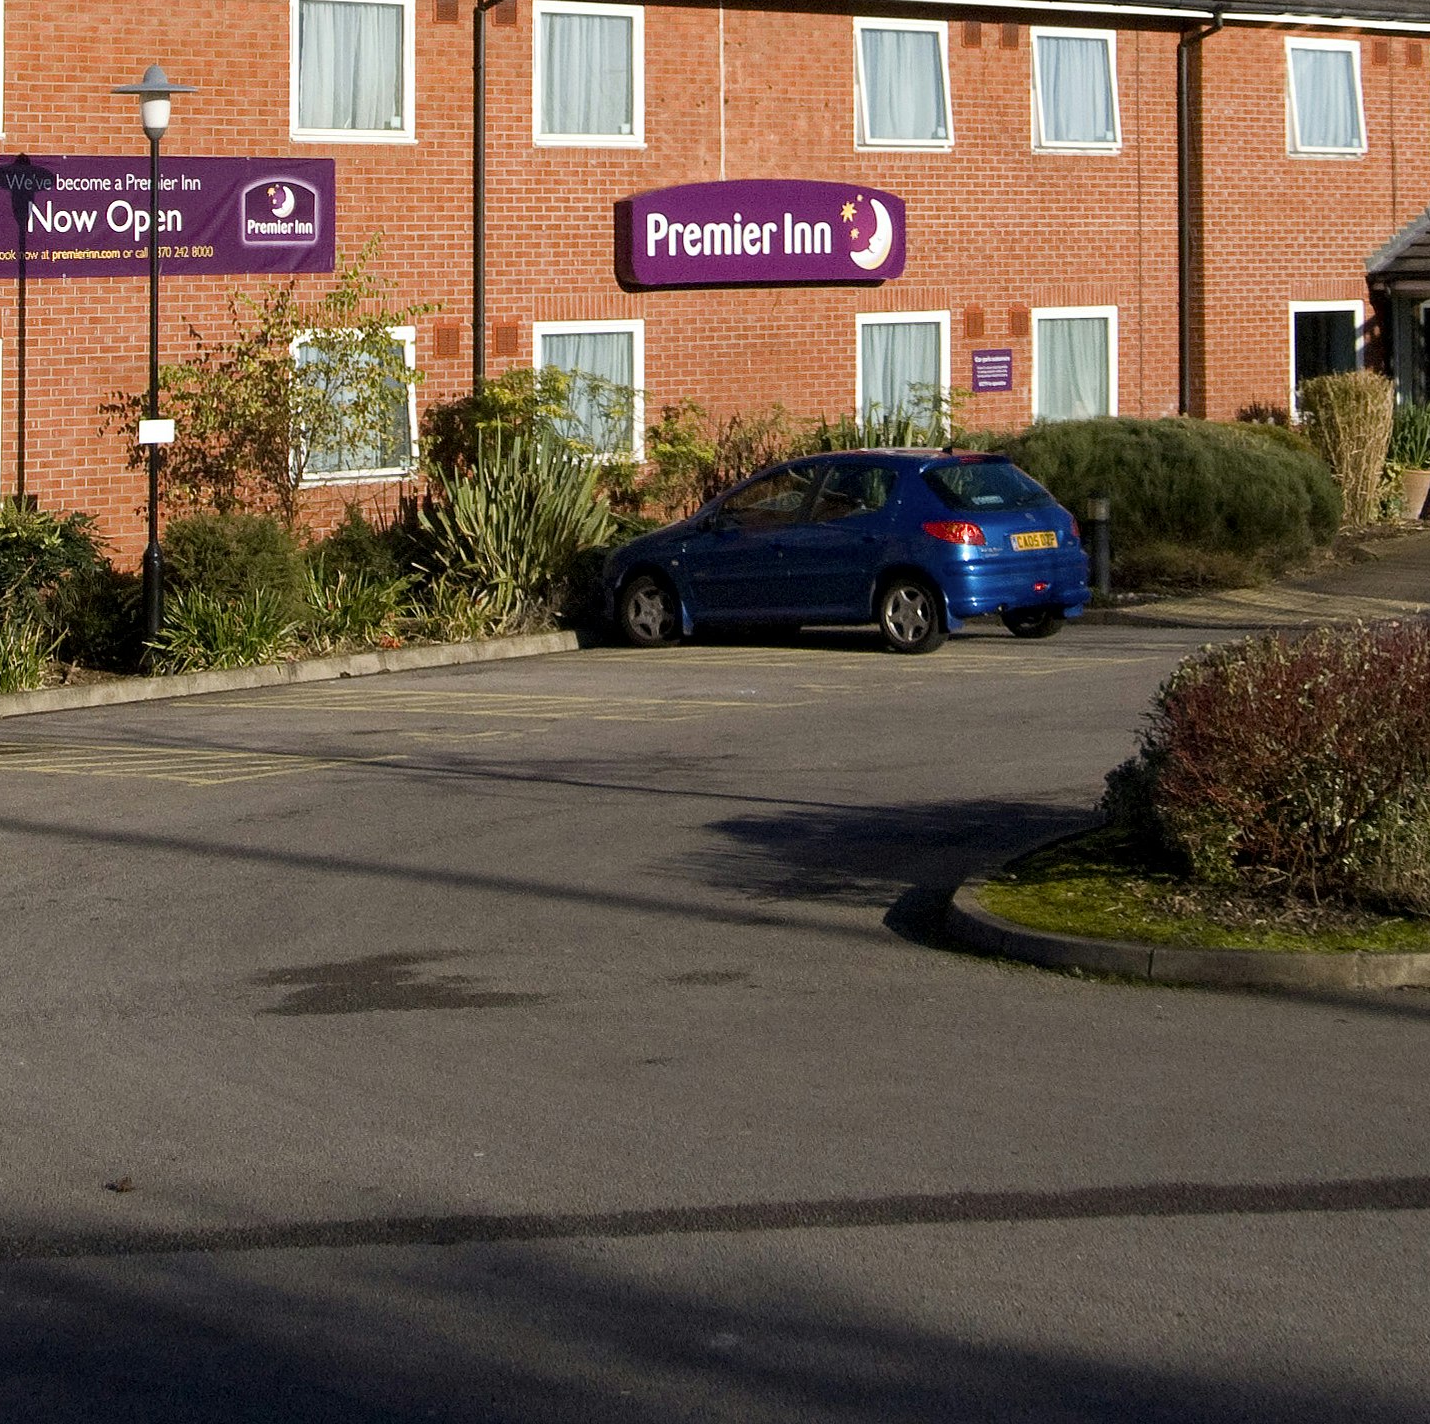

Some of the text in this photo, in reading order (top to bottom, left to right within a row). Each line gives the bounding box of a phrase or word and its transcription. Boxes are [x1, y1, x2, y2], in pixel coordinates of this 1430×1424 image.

[5, 173, 201, 191] We've become a Preier Inn
[27, 200, 98, 233] Now
[247, 219, 313, 235] Premier Inn
[646, 212, 832, 257] Premier Inn
[41, 248, 50, 260] at
[51, 247, 121, 263] premierinn.com
[122, 250, 133, 259] or
[135, 246, 149, 259] call
[173, 245, 189, 258] 242
[191, 245, 214, 258] 8000
